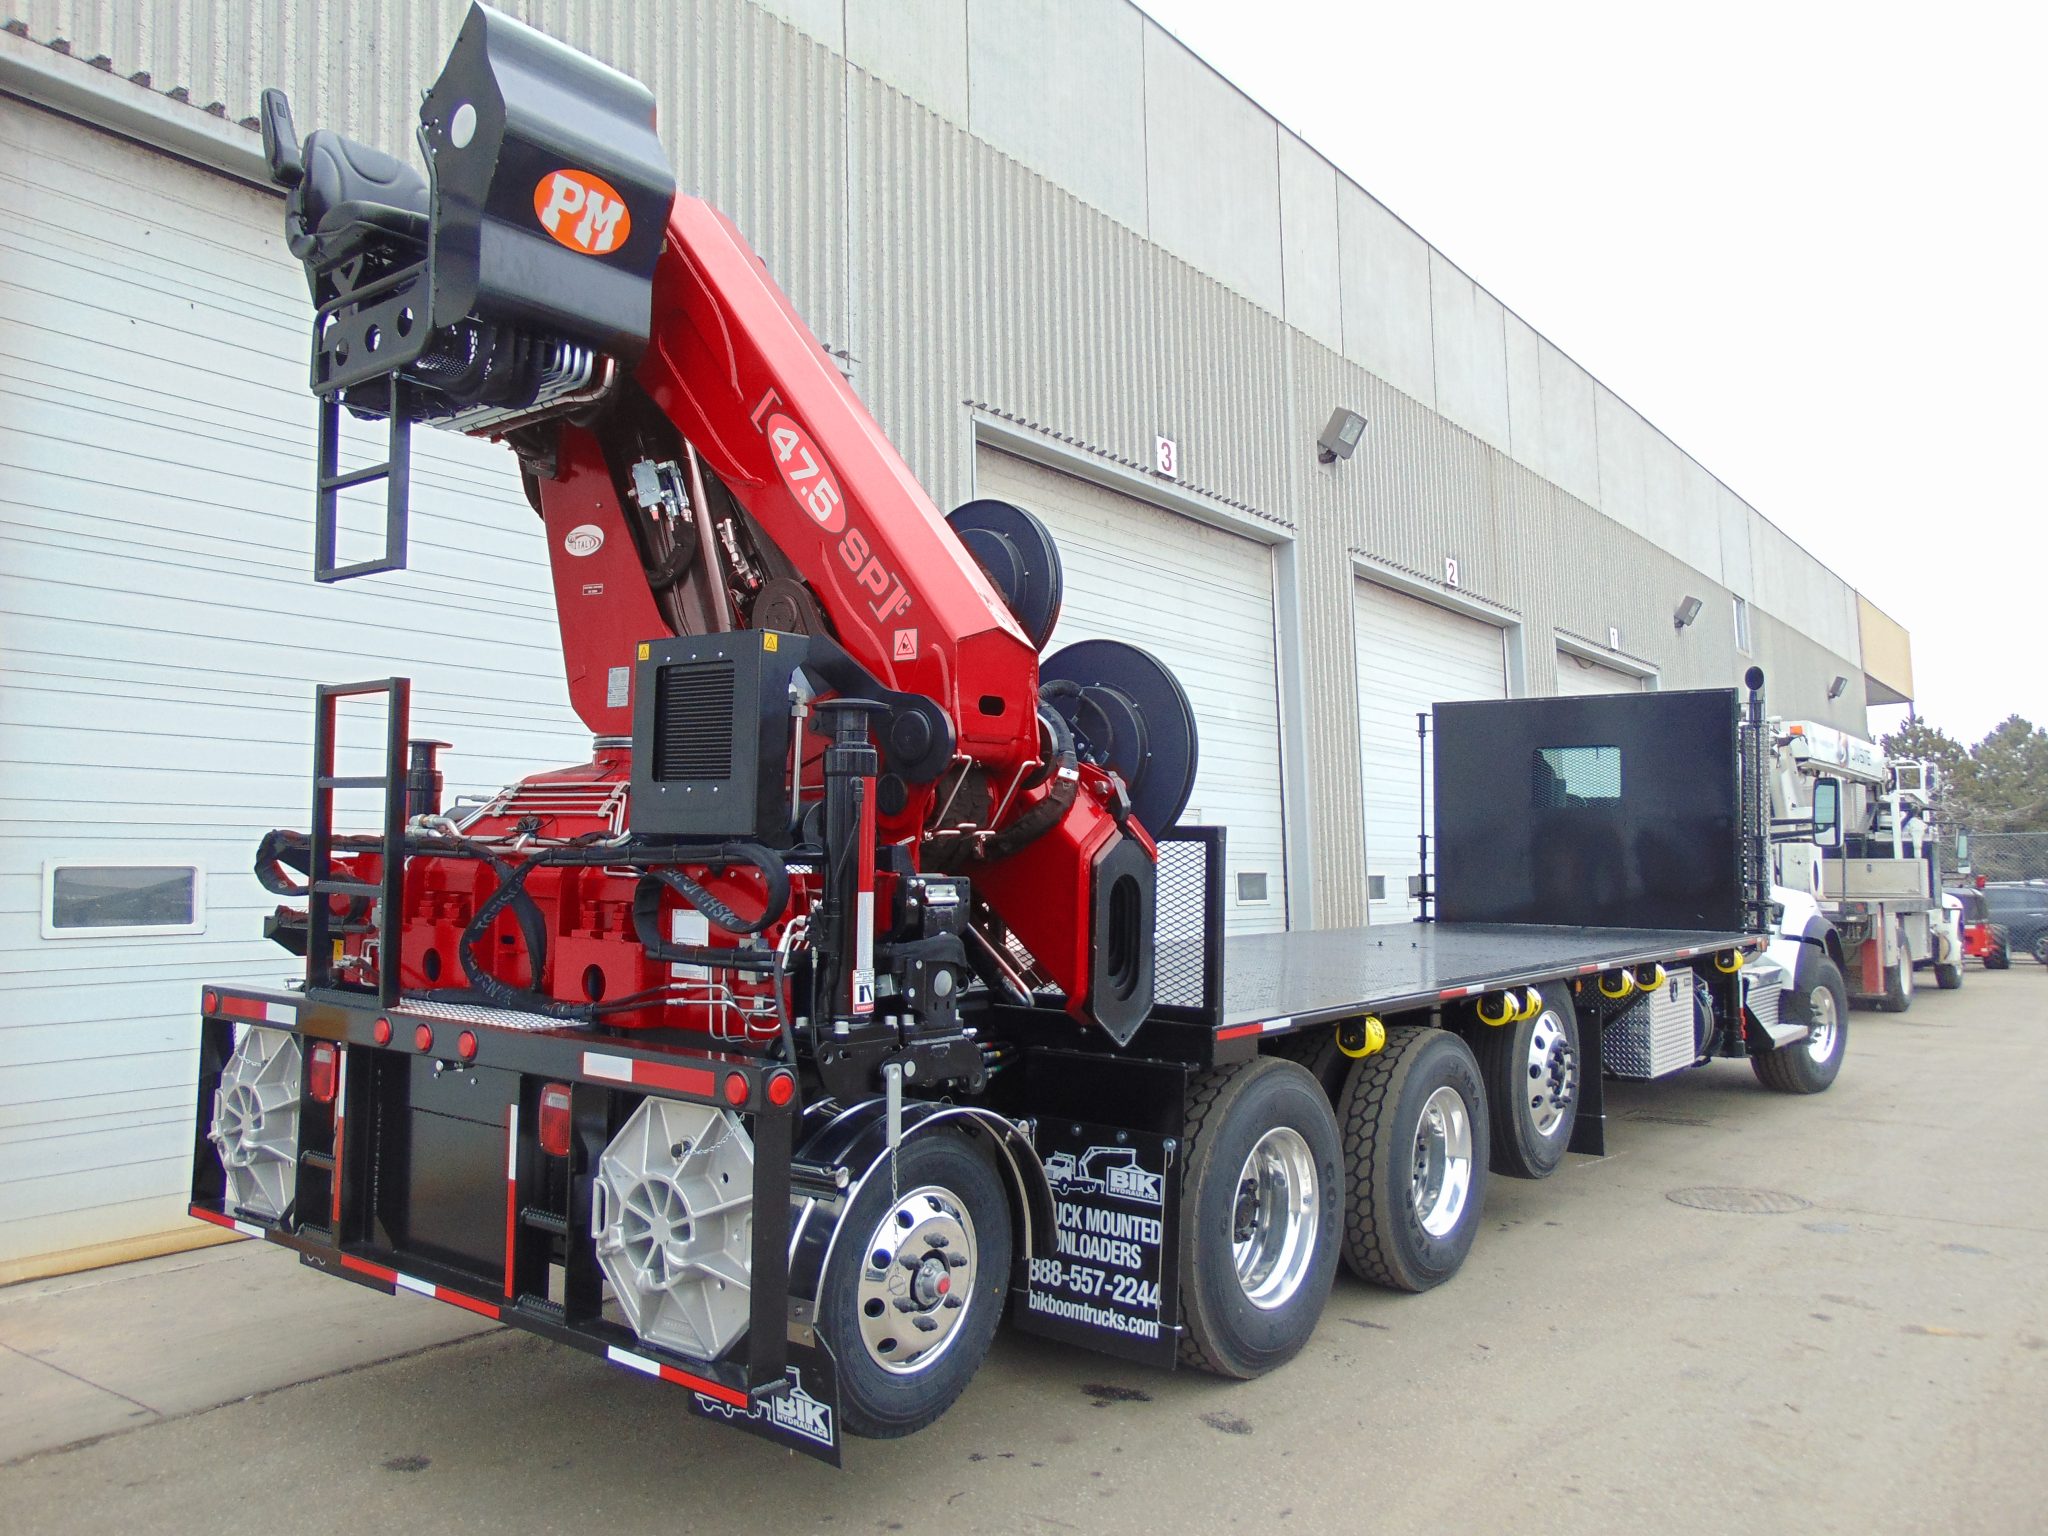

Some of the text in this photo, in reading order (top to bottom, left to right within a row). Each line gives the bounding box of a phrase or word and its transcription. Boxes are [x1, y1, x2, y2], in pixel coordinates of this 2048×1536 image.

[541, 173, 625, 251] PM
[1161, 442, 1172, 472] 3
[771, 427, 840, 522] 47.5
[1448, 562, 1456, 584] 2
[1110, 1169, 1158, 1198] BIK
[1110, 1186, 1159, 1201] HYDRAULICS
[1086, 1206, 1161, 1245] MOUNTED
[1028, 1288, 1160, 1339] bikboomtrucks.com
[776, 1396, 828, 1431] BIK
[776, 1412, 829, 1440] HYDRAULICS
